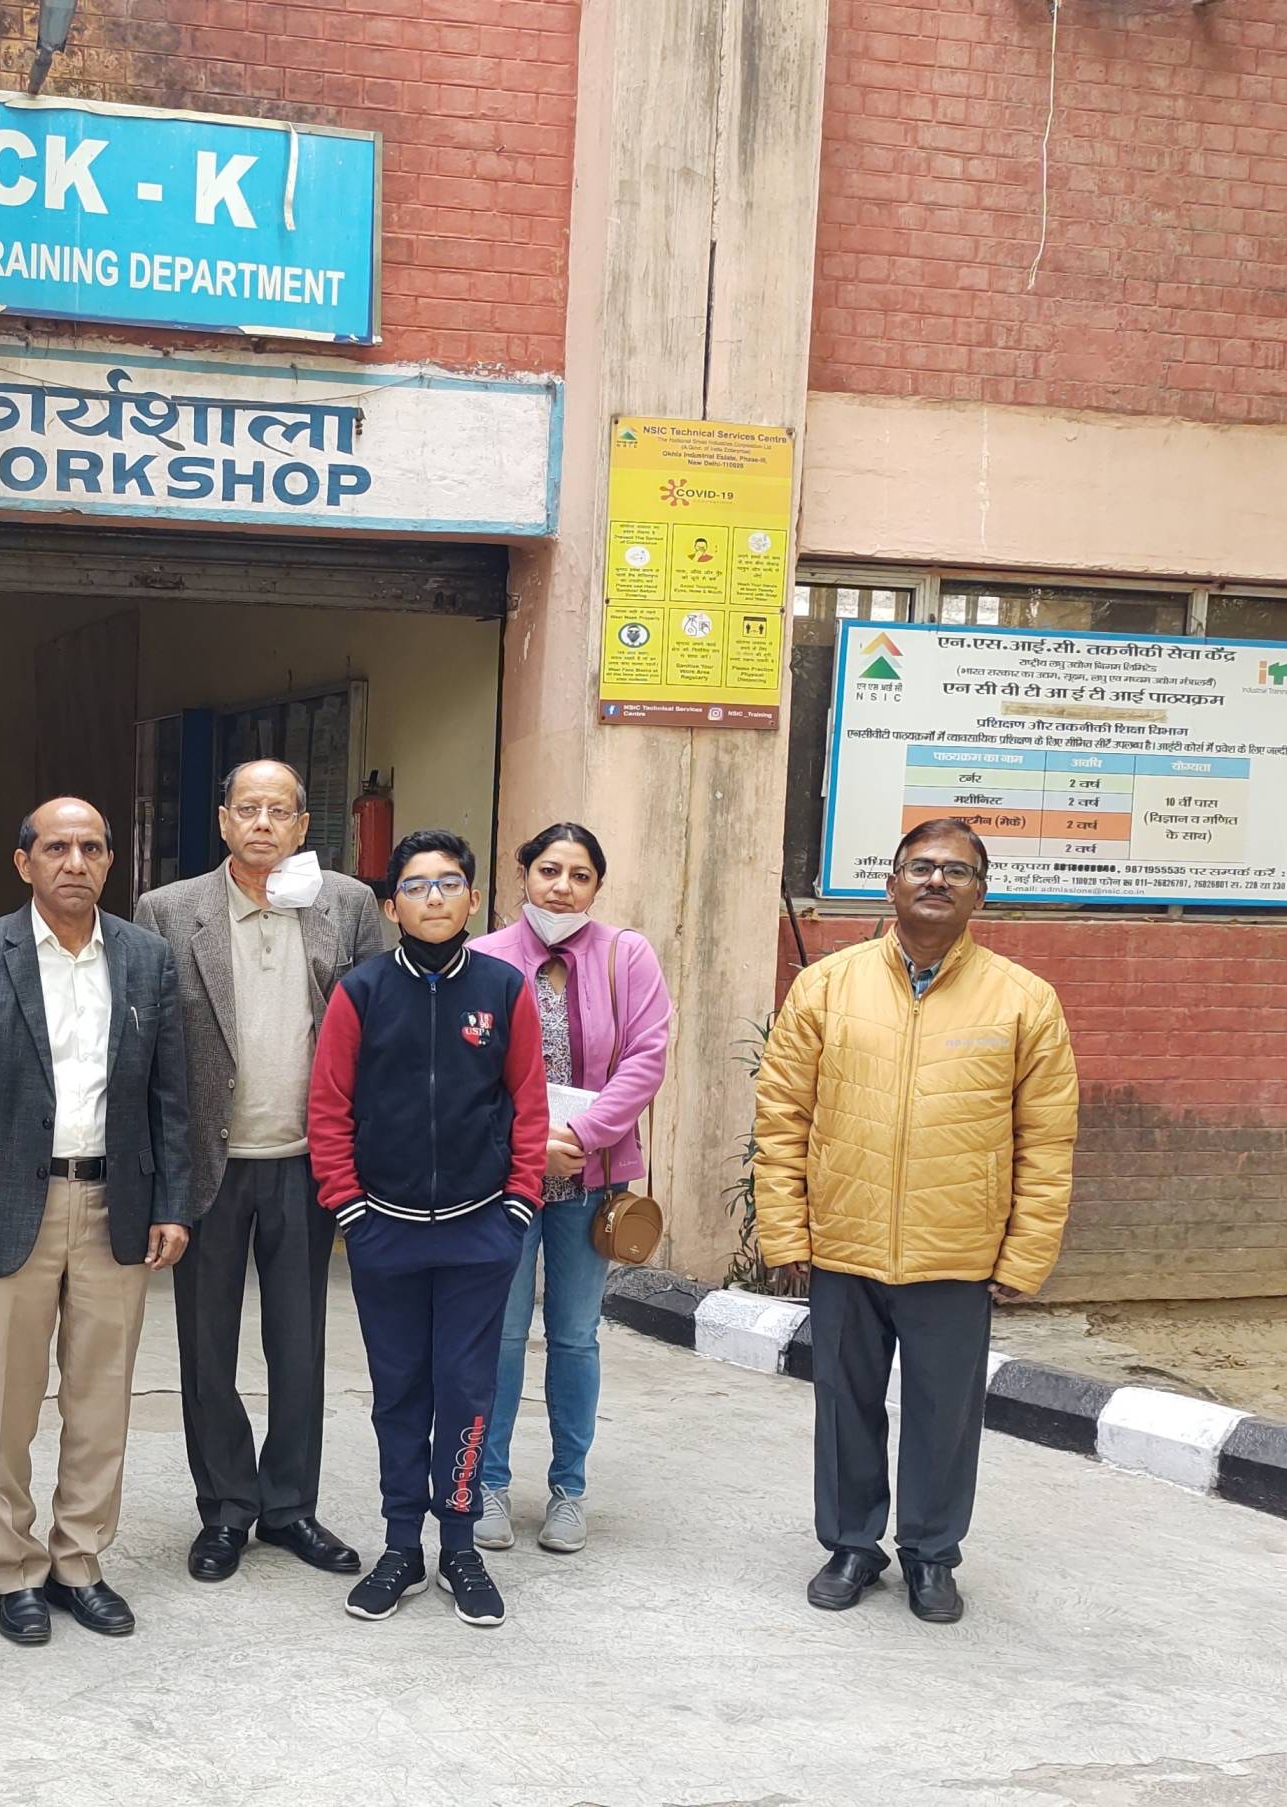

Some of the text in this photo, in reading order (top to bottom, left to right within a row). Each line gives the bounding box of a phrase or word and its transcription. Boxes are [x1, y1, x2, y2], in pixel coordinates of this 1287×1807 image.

[137, 183, 163, 202] -
[195, 150, 259, 229] K
[129, 251, 346, 306] DEPARTMENT
[643, 426, 787, 443] NSIC Technical Services Centre
[676, 488, 734, 500] COVID-19
[1086, 642, 1162, 658] तकनीकी
[1167, 646, 1200, 661] सेवा
[1204, 647, 1237, 662] केंद्र
[1021, 670, 1034, 678] का
[943, 682, 1226, 706] एन सी वी टी आ ई टी आई पाठ्यक्रम
[976, 717, 1188, 737] प्रशिक्षण और तकनीकी शिक्षा विभाग
[937, 731, 945, 742] में
[999, 734, 1032, 745] प्रशिक्षण
[1034, 734, 1044, 745] के
[1046, 736, 1064, 747] लिए
[1184, 741, 1203, 752] कोर्स
[1205, 741, 1214, 752] में
[1237, 743, 1246, 754] के
[1248, 744, 1265, 755] लिए
[983, 753, 999, 763] का
[1070, 778, 1102, 789] 2 वर्ष
[954, 794, 1003, 805] मशीनिस्ट
[1068, 797, 1099, 808] 2 वर्ष
[1166, 797, 1175, 807] 10
[1194, 799, 1218, 808] पास
[1144, 811, 1238, 826] (विज्ञान व गणित
[1066, 820, 1098, 831] 2 वर्ष
[1166, 830, 1212, 843] के साथ)
[1065, 843, 1096, 854] 2 वर्ष
[1012, 863, 1050, 873] कृपया
[1189, 868, 1205, 876] पर
[1209, 867, 1250, 876] सम्पर्क
[1015, 876, 1030, 885] नई
[1032, 875, 1060, 885] दिल्ली
[452, 1424, 487, 1483] UCB
